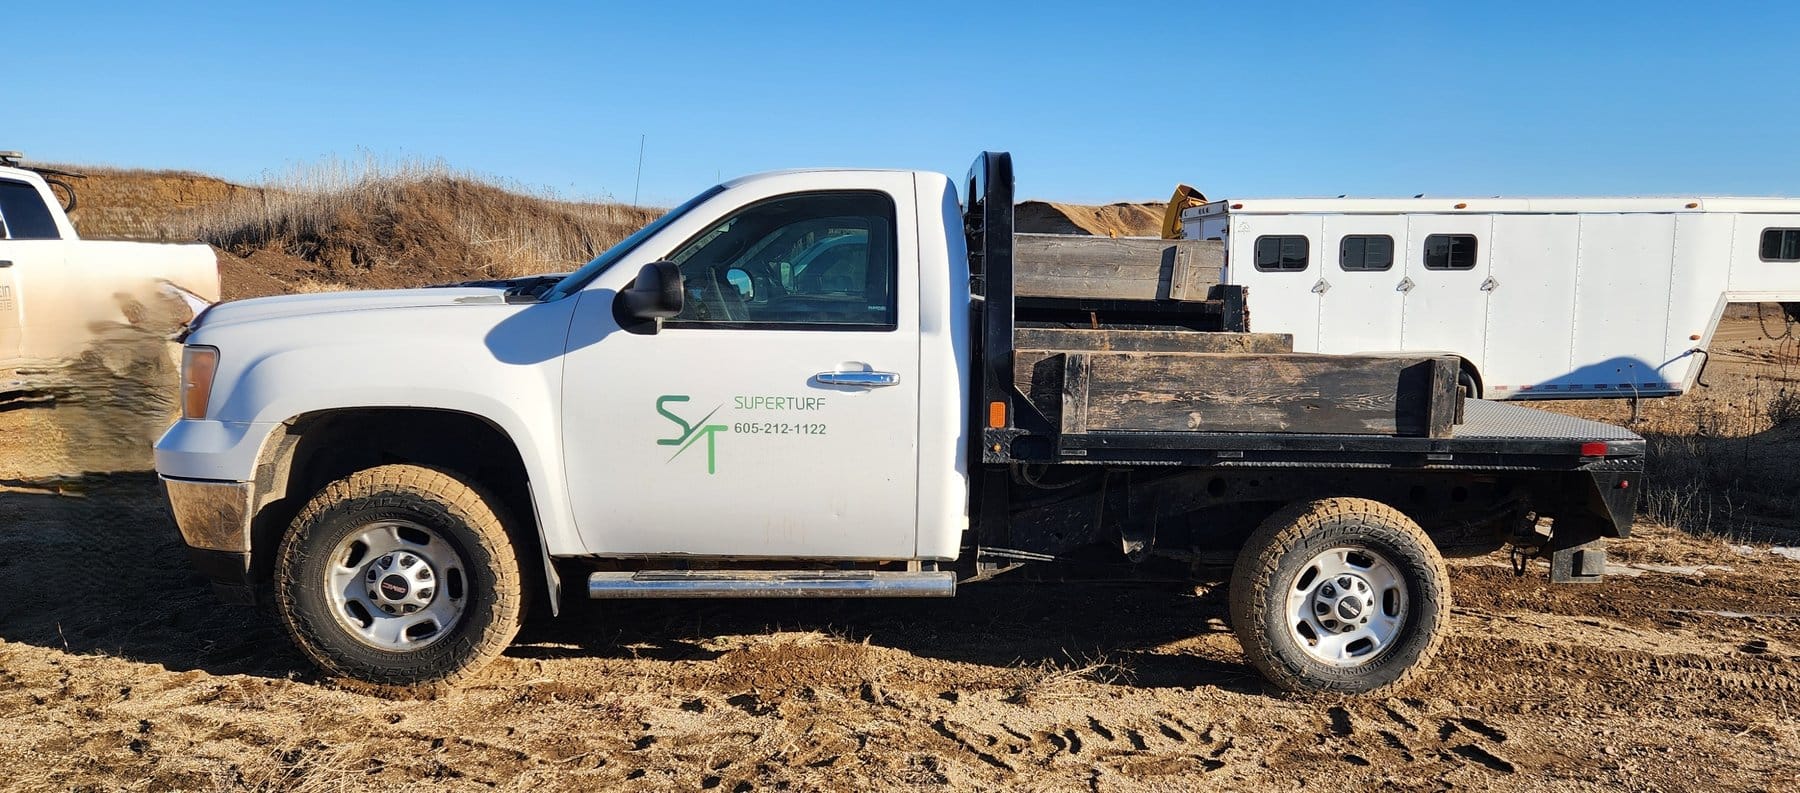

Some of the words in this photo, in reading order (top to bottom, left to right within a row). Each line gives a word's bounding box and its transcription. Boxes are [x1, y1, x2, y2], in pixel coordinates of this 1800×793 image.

[734, 396, 827, 411] SUPERTURF
[734, 422, 827, 435] 605-212-1122
[382, 582, 407, 594] GMC
